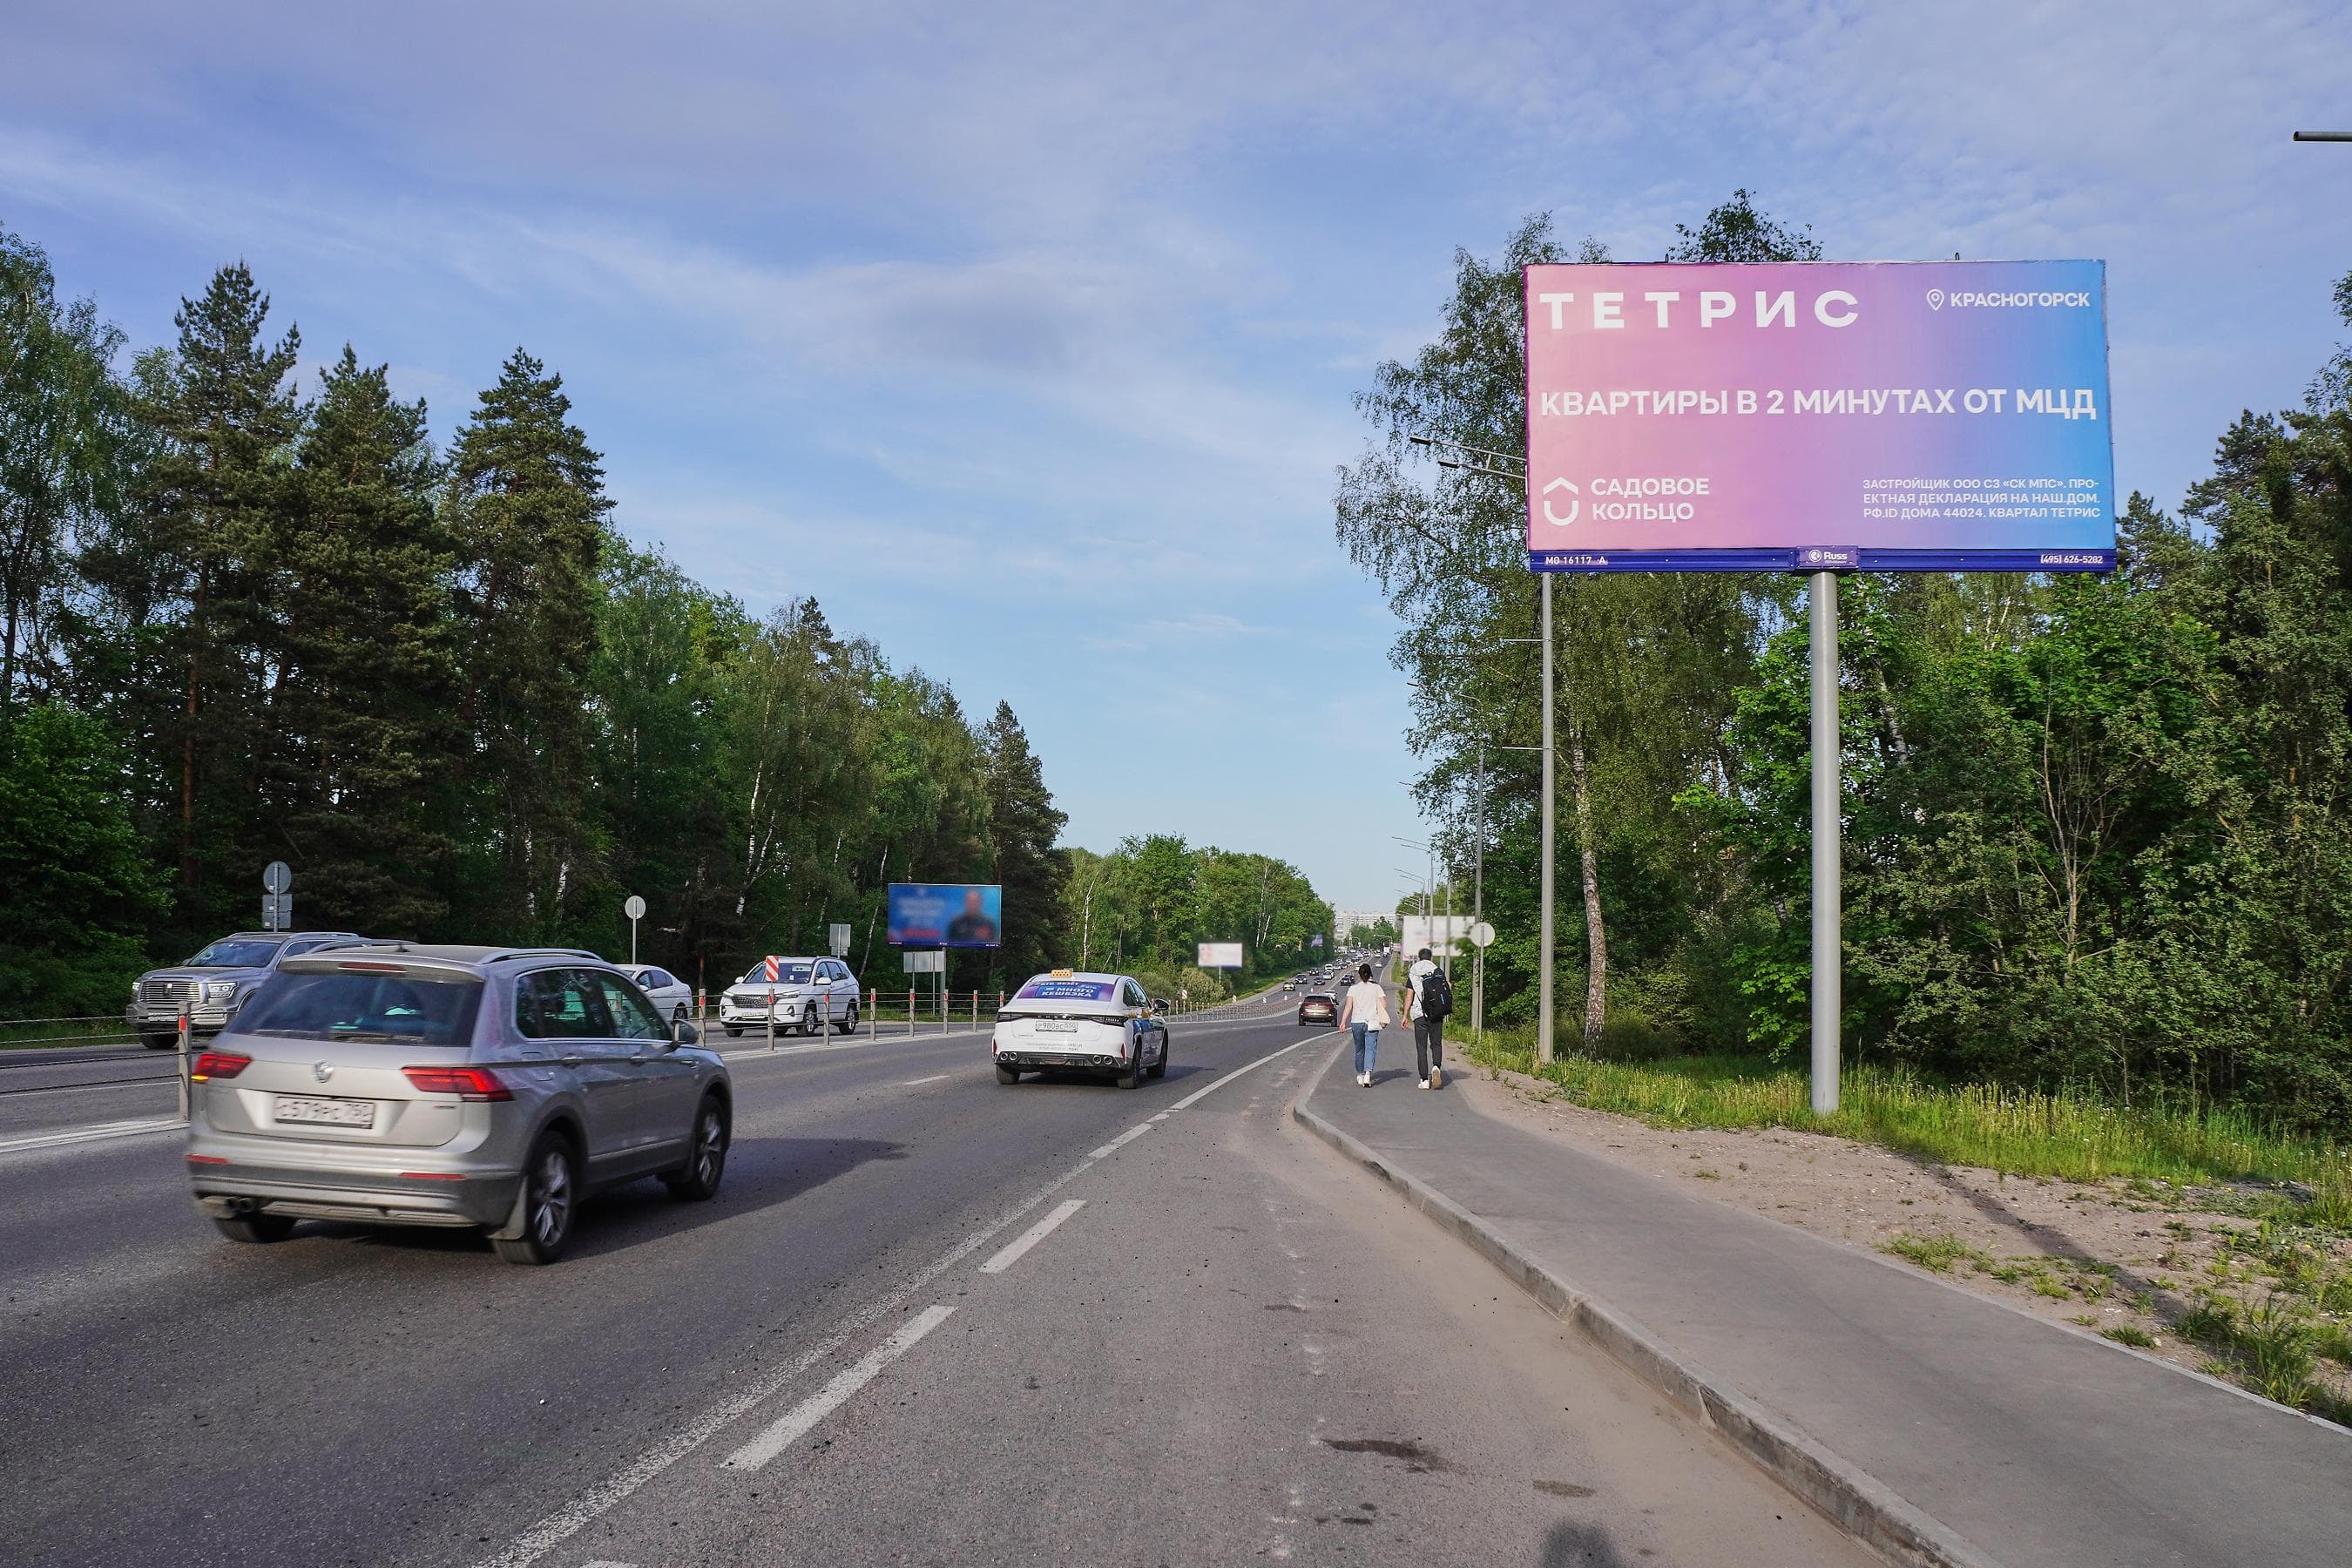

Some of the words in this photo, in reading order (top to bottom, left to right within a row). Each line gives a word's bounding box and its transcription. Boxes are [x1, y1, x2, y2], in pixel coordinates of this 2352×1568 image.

[1950, 292, 2091, 308] КРАСНОГОРСК
[1539, 290, 1859, 329] ТЕТРИС
[1539, 389, 1728, 416] КВАРТИРЫ
[1736, 389, 1758, 415] В
[1766, 389, 1785, 415] 2
[1793, 389, 1956, 416] МИНУТАХ
[1963, 389, 2008, 414] ОТ
[2016, 389, 2098, 421] МЦД
[1591, 477, 1710, 498] САДОВОЕ
[1862, 477, 1950, 490] ЗАСТРОЙЩИК
[1953, 478, 1981, 490] ООО
[1984, 478, 2001, 490] СЗ
[2003, 478, 2028, 490] «СК
[2029, 478, 2067, 490] МПС».
[2069, 478, 2099, 490] ПРО-
[1863, 493, 1916, 504] ЕКТНАЯ
[1918, 492, 2008, 506] ДЕКЛАРАЦИЯ
[2011, 493, 2030, 504] НА
[1592, 502, 1694, 523] КОЛЬЦО
[1863, 507, 1898, 519] РФ.ID
[1901, 507, 1942, 520] ДОМА
[1943, 507, 1986, 519] 44024.
[1989, 507, 2048, 519] КВАРТАЛ
[2050, 507, 2101, 519] ТЕТРИС
[1563, 556, 1592, 565] 16117
[1823, 551, 1848, 560] Russ
